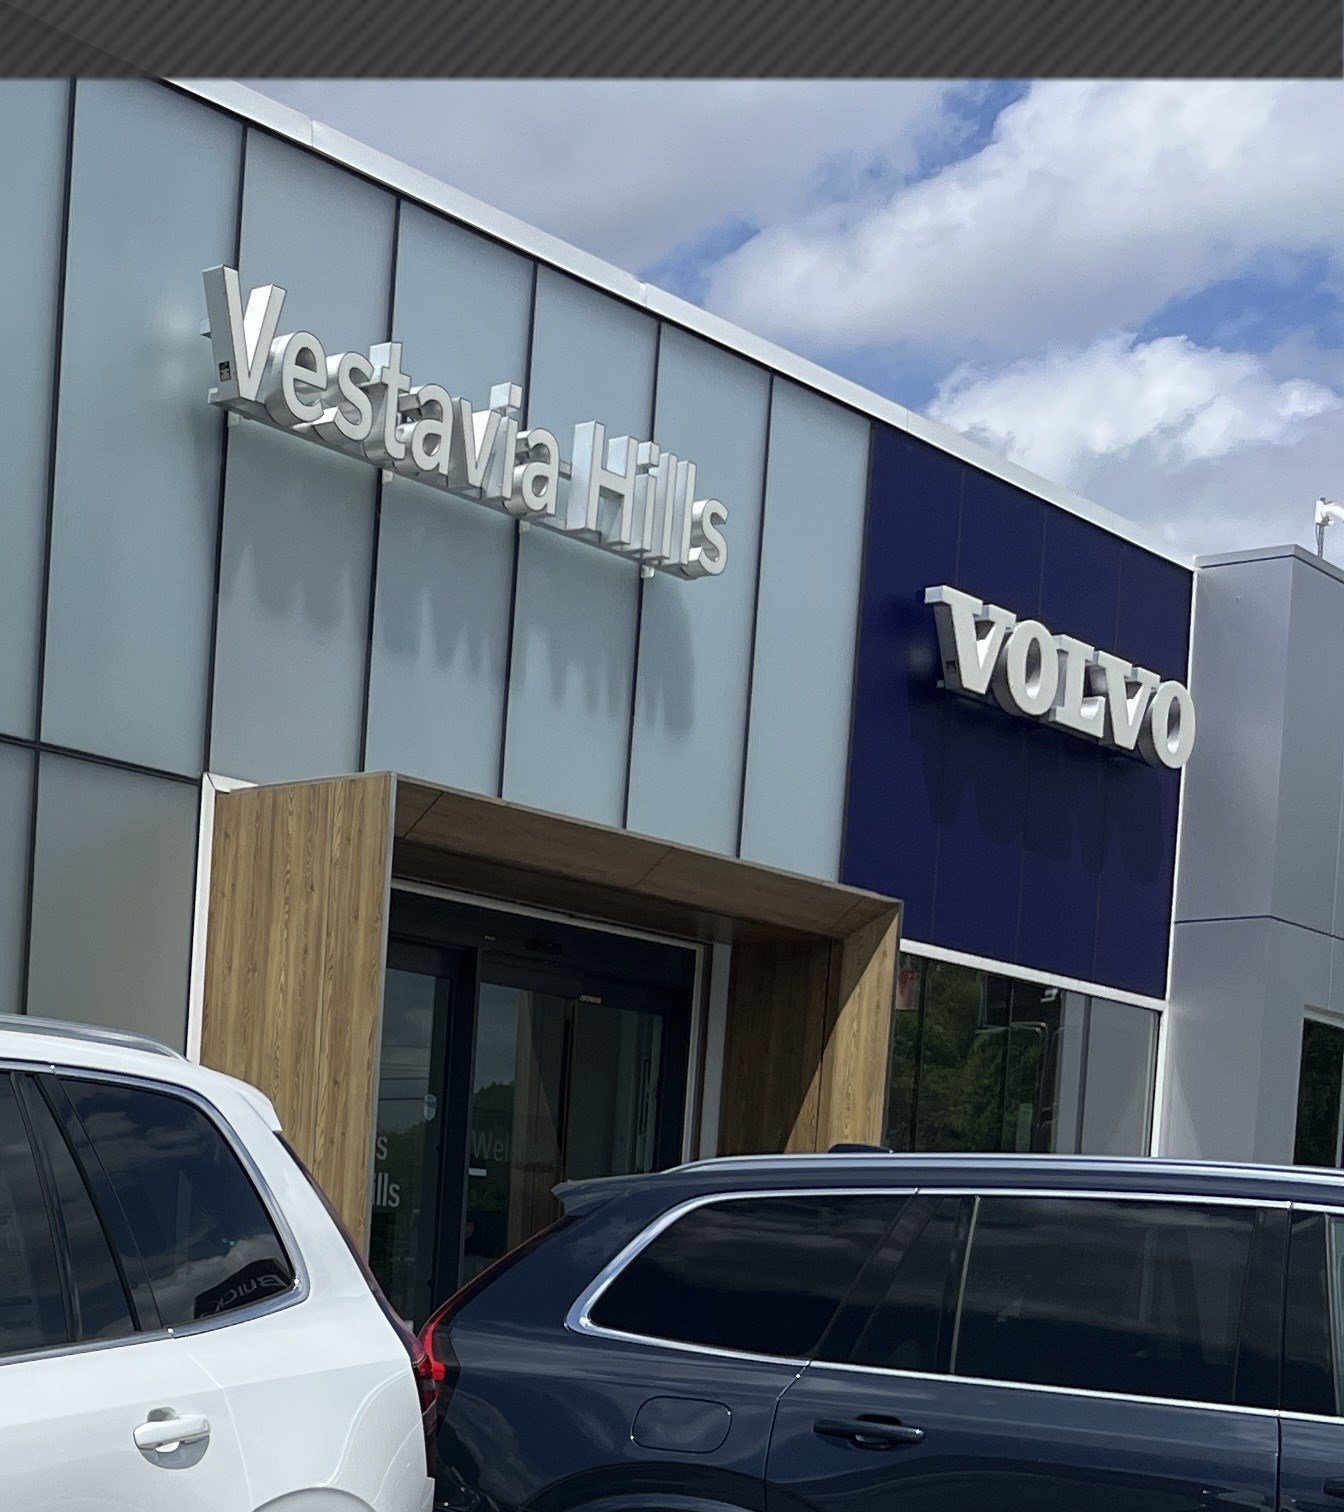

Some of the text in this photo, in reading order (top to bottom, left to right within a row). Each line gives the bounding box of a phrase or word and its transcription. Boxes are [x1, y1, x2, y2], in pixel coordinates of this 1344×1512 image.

[202, 265, 728, 580] Vestavia Hills
[925, 585, 1196, 769] VOLVO
